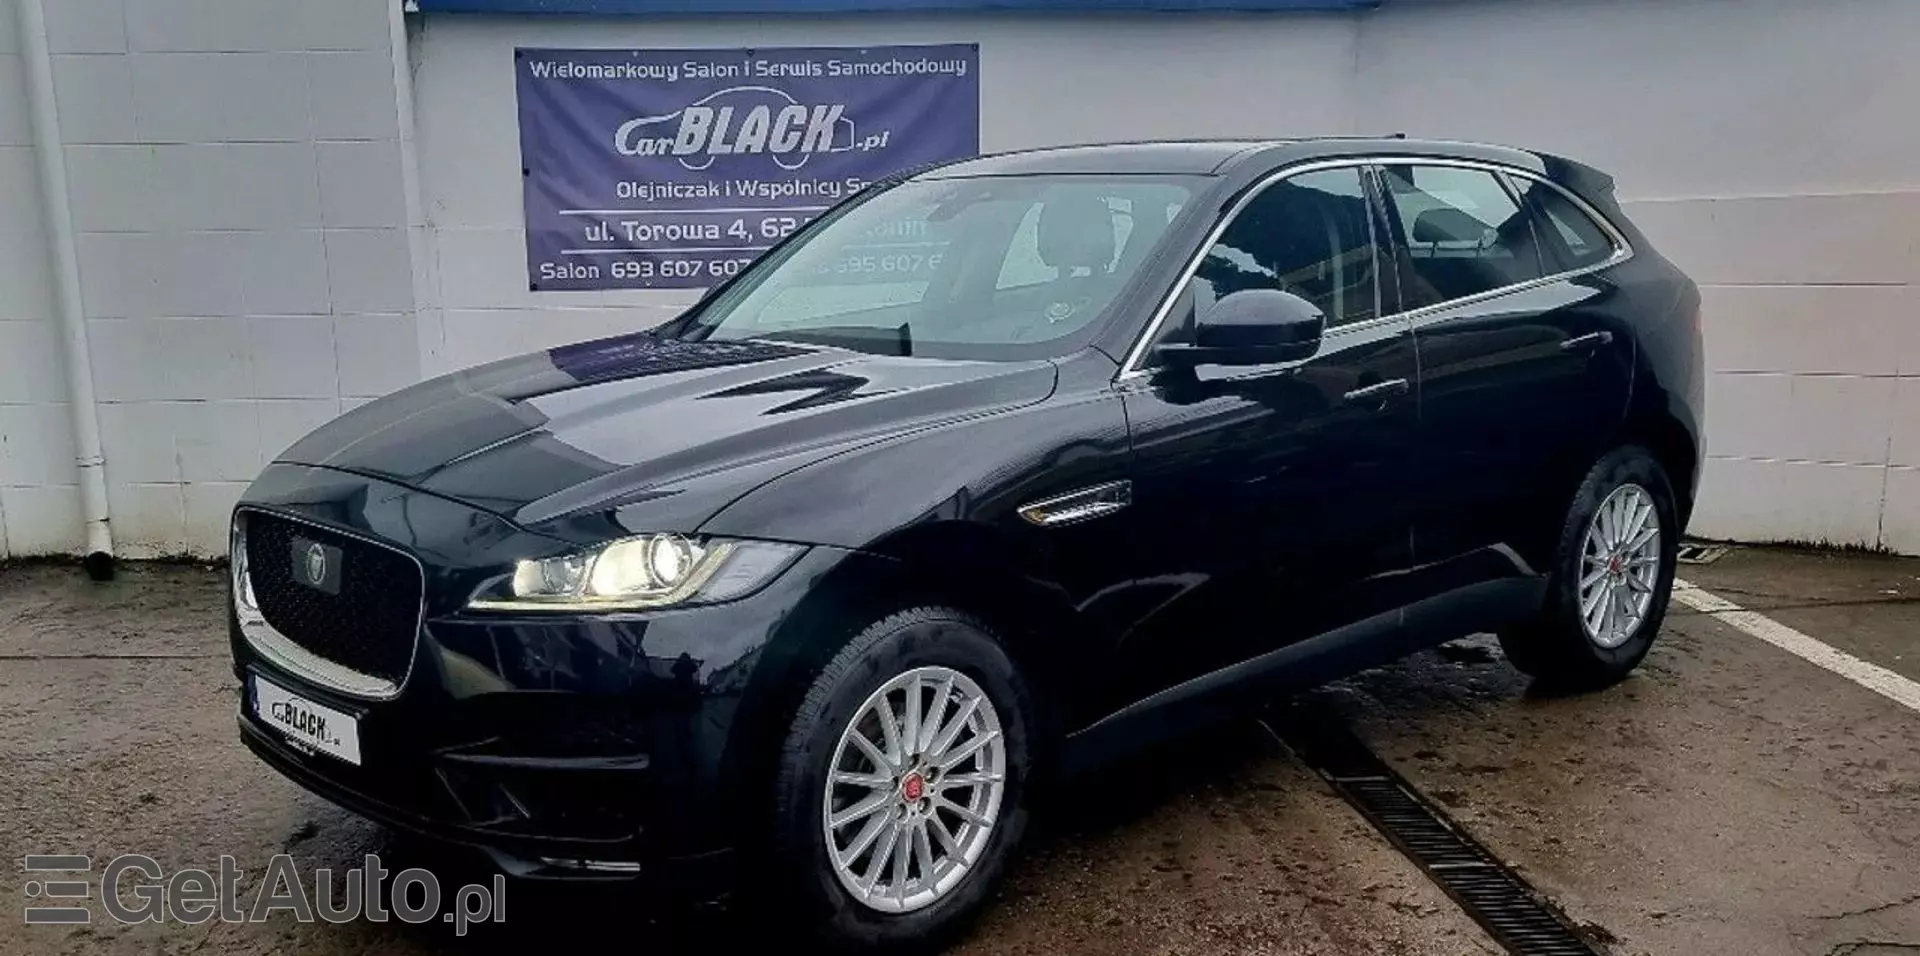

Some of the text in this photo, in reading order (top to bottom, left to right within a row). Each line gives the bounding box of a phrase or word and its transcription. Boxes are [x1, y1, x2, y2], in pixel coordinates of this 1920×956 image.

[530, 57, 967, 82] Wielomarkowy Salon i Serwis Samochodowy
[616, 180, 720, 201] Olejniczak
[725, 180, 731, 197] i
[736, 178, 841, 200] Wspólnicy
[584, 221, 615, 242] ul.
[621, 220, 720, 242] Torowa
[727, 218, 753, 243] 4,
[539, 262, 600, 280] Salon
[611, 260, 654, 278] 693
[660, 260, 703, 277] 607
